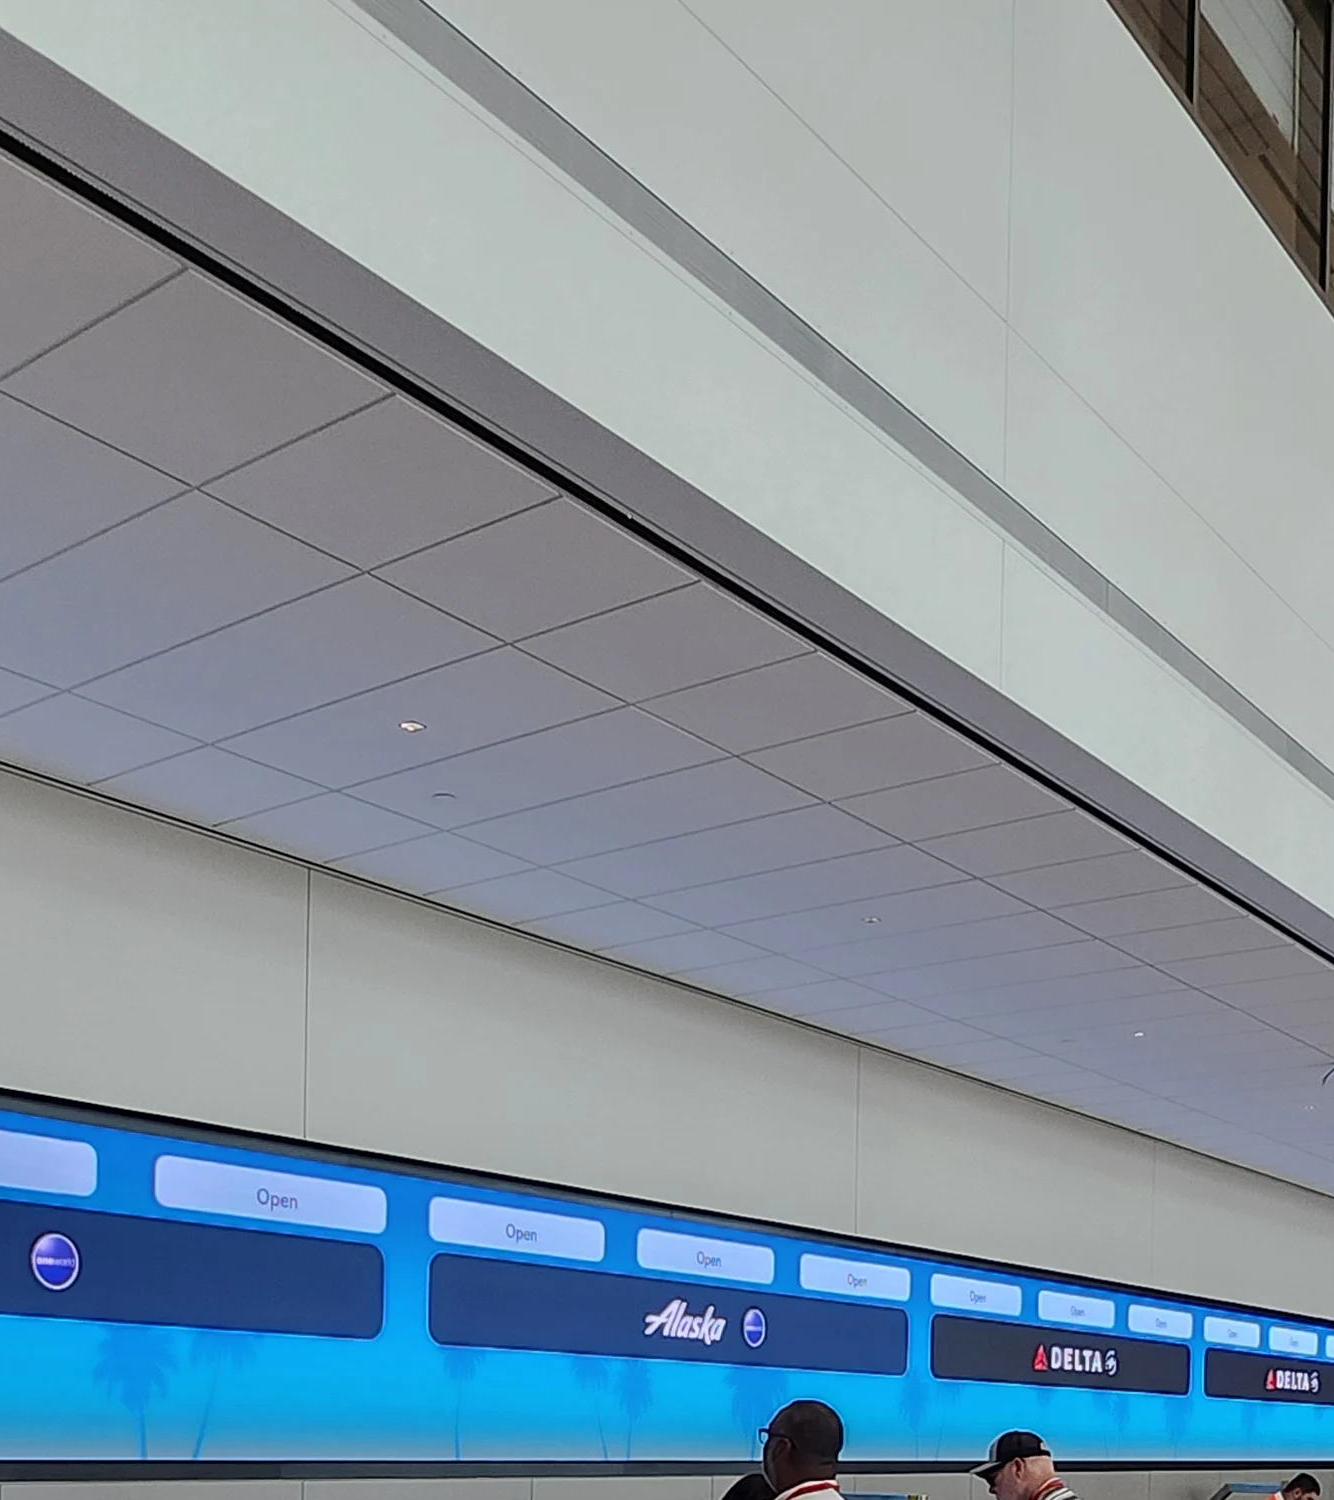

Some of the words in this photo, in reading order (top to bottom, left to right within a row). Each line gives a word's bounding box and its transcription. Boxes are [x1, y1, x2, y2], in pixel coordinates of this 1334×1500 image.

[257, 1187, 298, 1211] Open
[505, 1223, 538, 1244] Open
[696, 1250, 722, 1270] Open
[644, 1299, 727, 1346] Alaska
[1050, 1346, 1103, 1373] DELTA
[1275, 1369, 1310, 1392] DELTA
